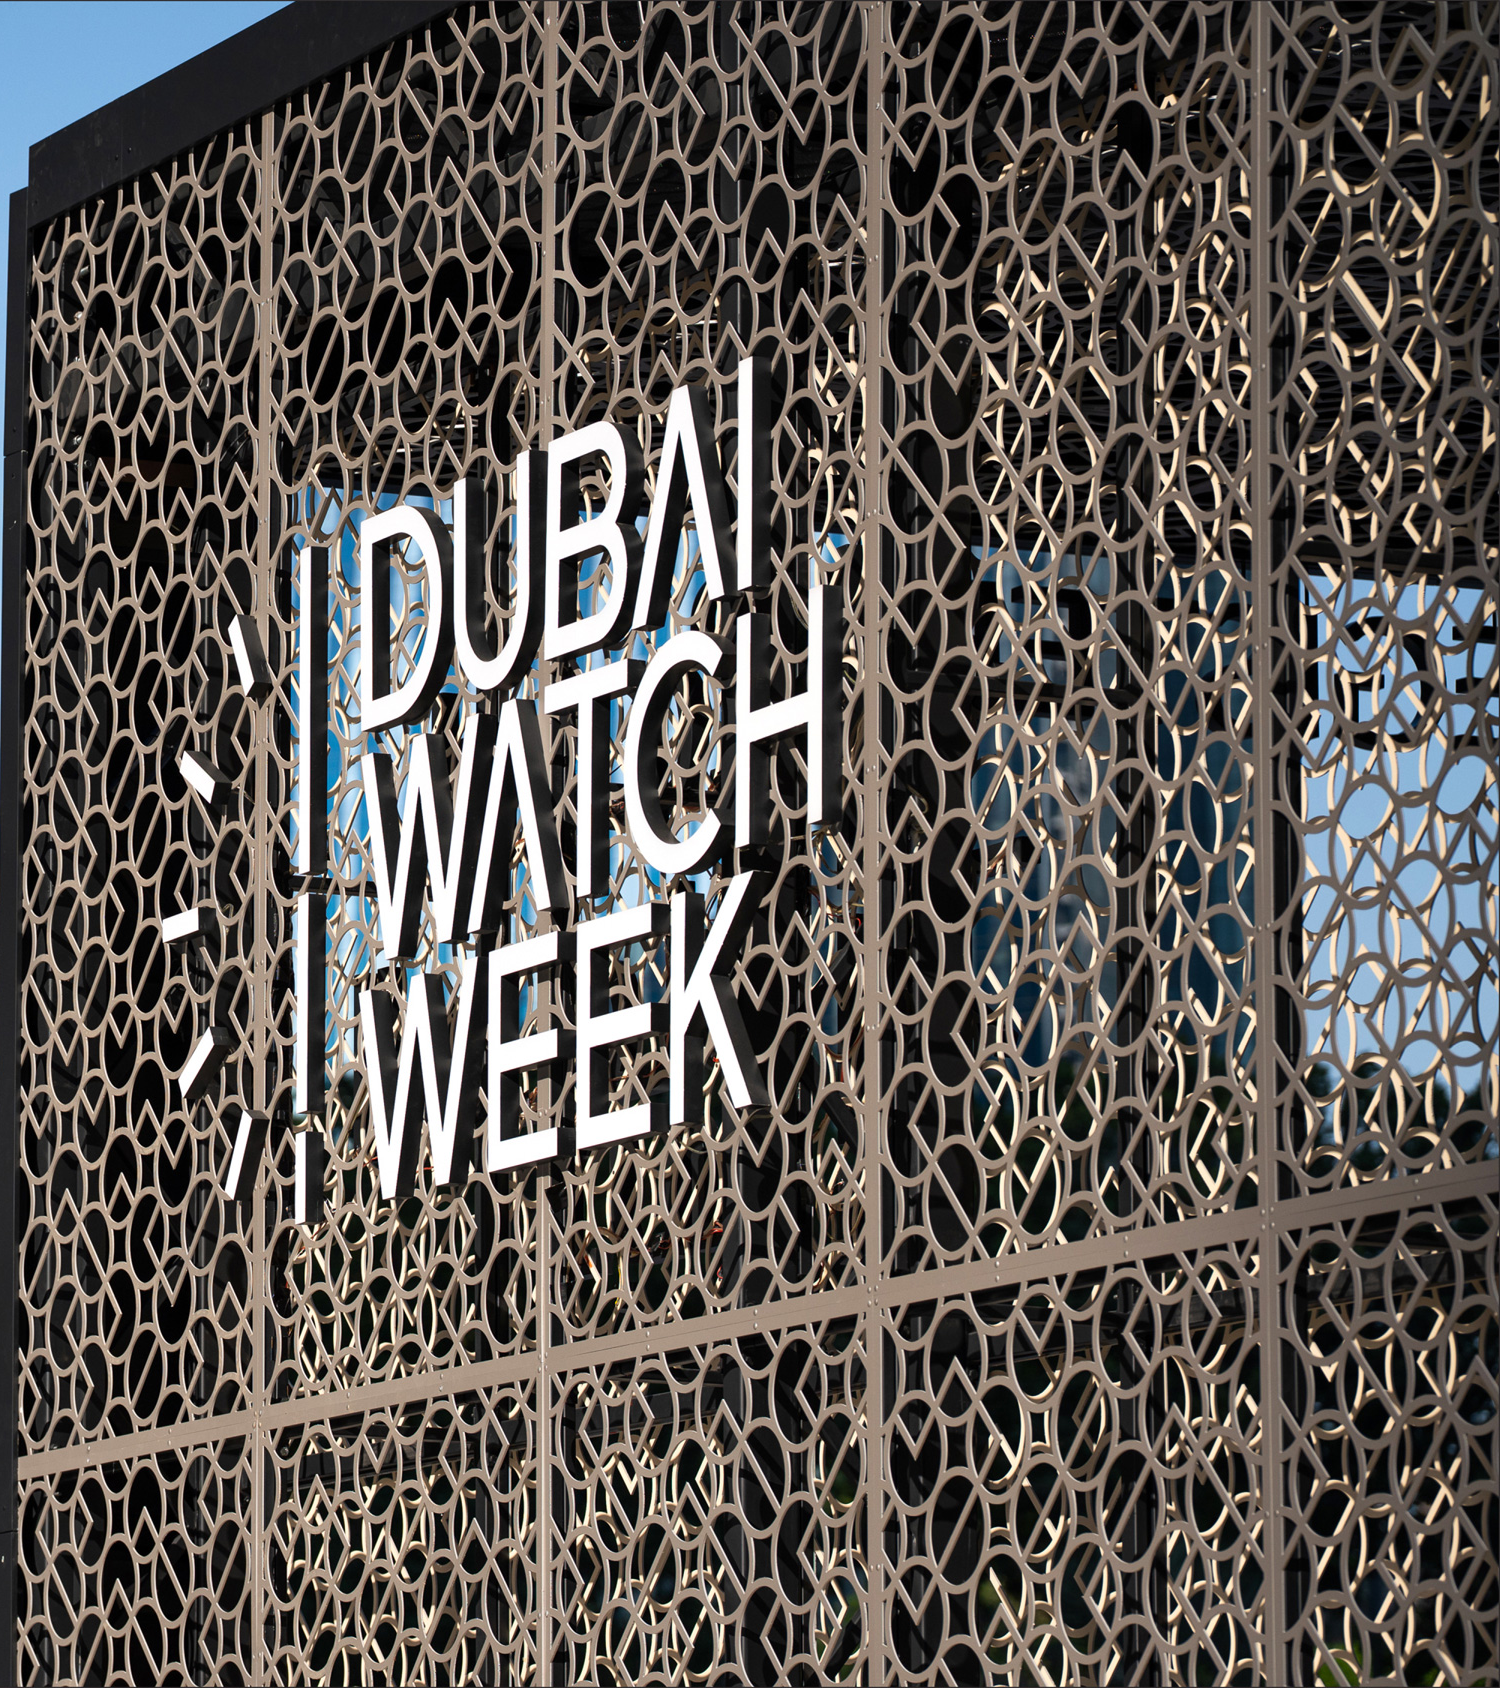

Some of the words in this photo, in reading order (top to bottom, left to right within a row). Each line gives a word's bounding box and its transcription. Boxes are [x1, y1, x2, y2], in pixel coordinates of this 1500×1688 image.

[360, 357, 762, 732] DUBAI
[362, 584, 831, 959] WATCH
[359, 870, 762, 1200] WEEK
